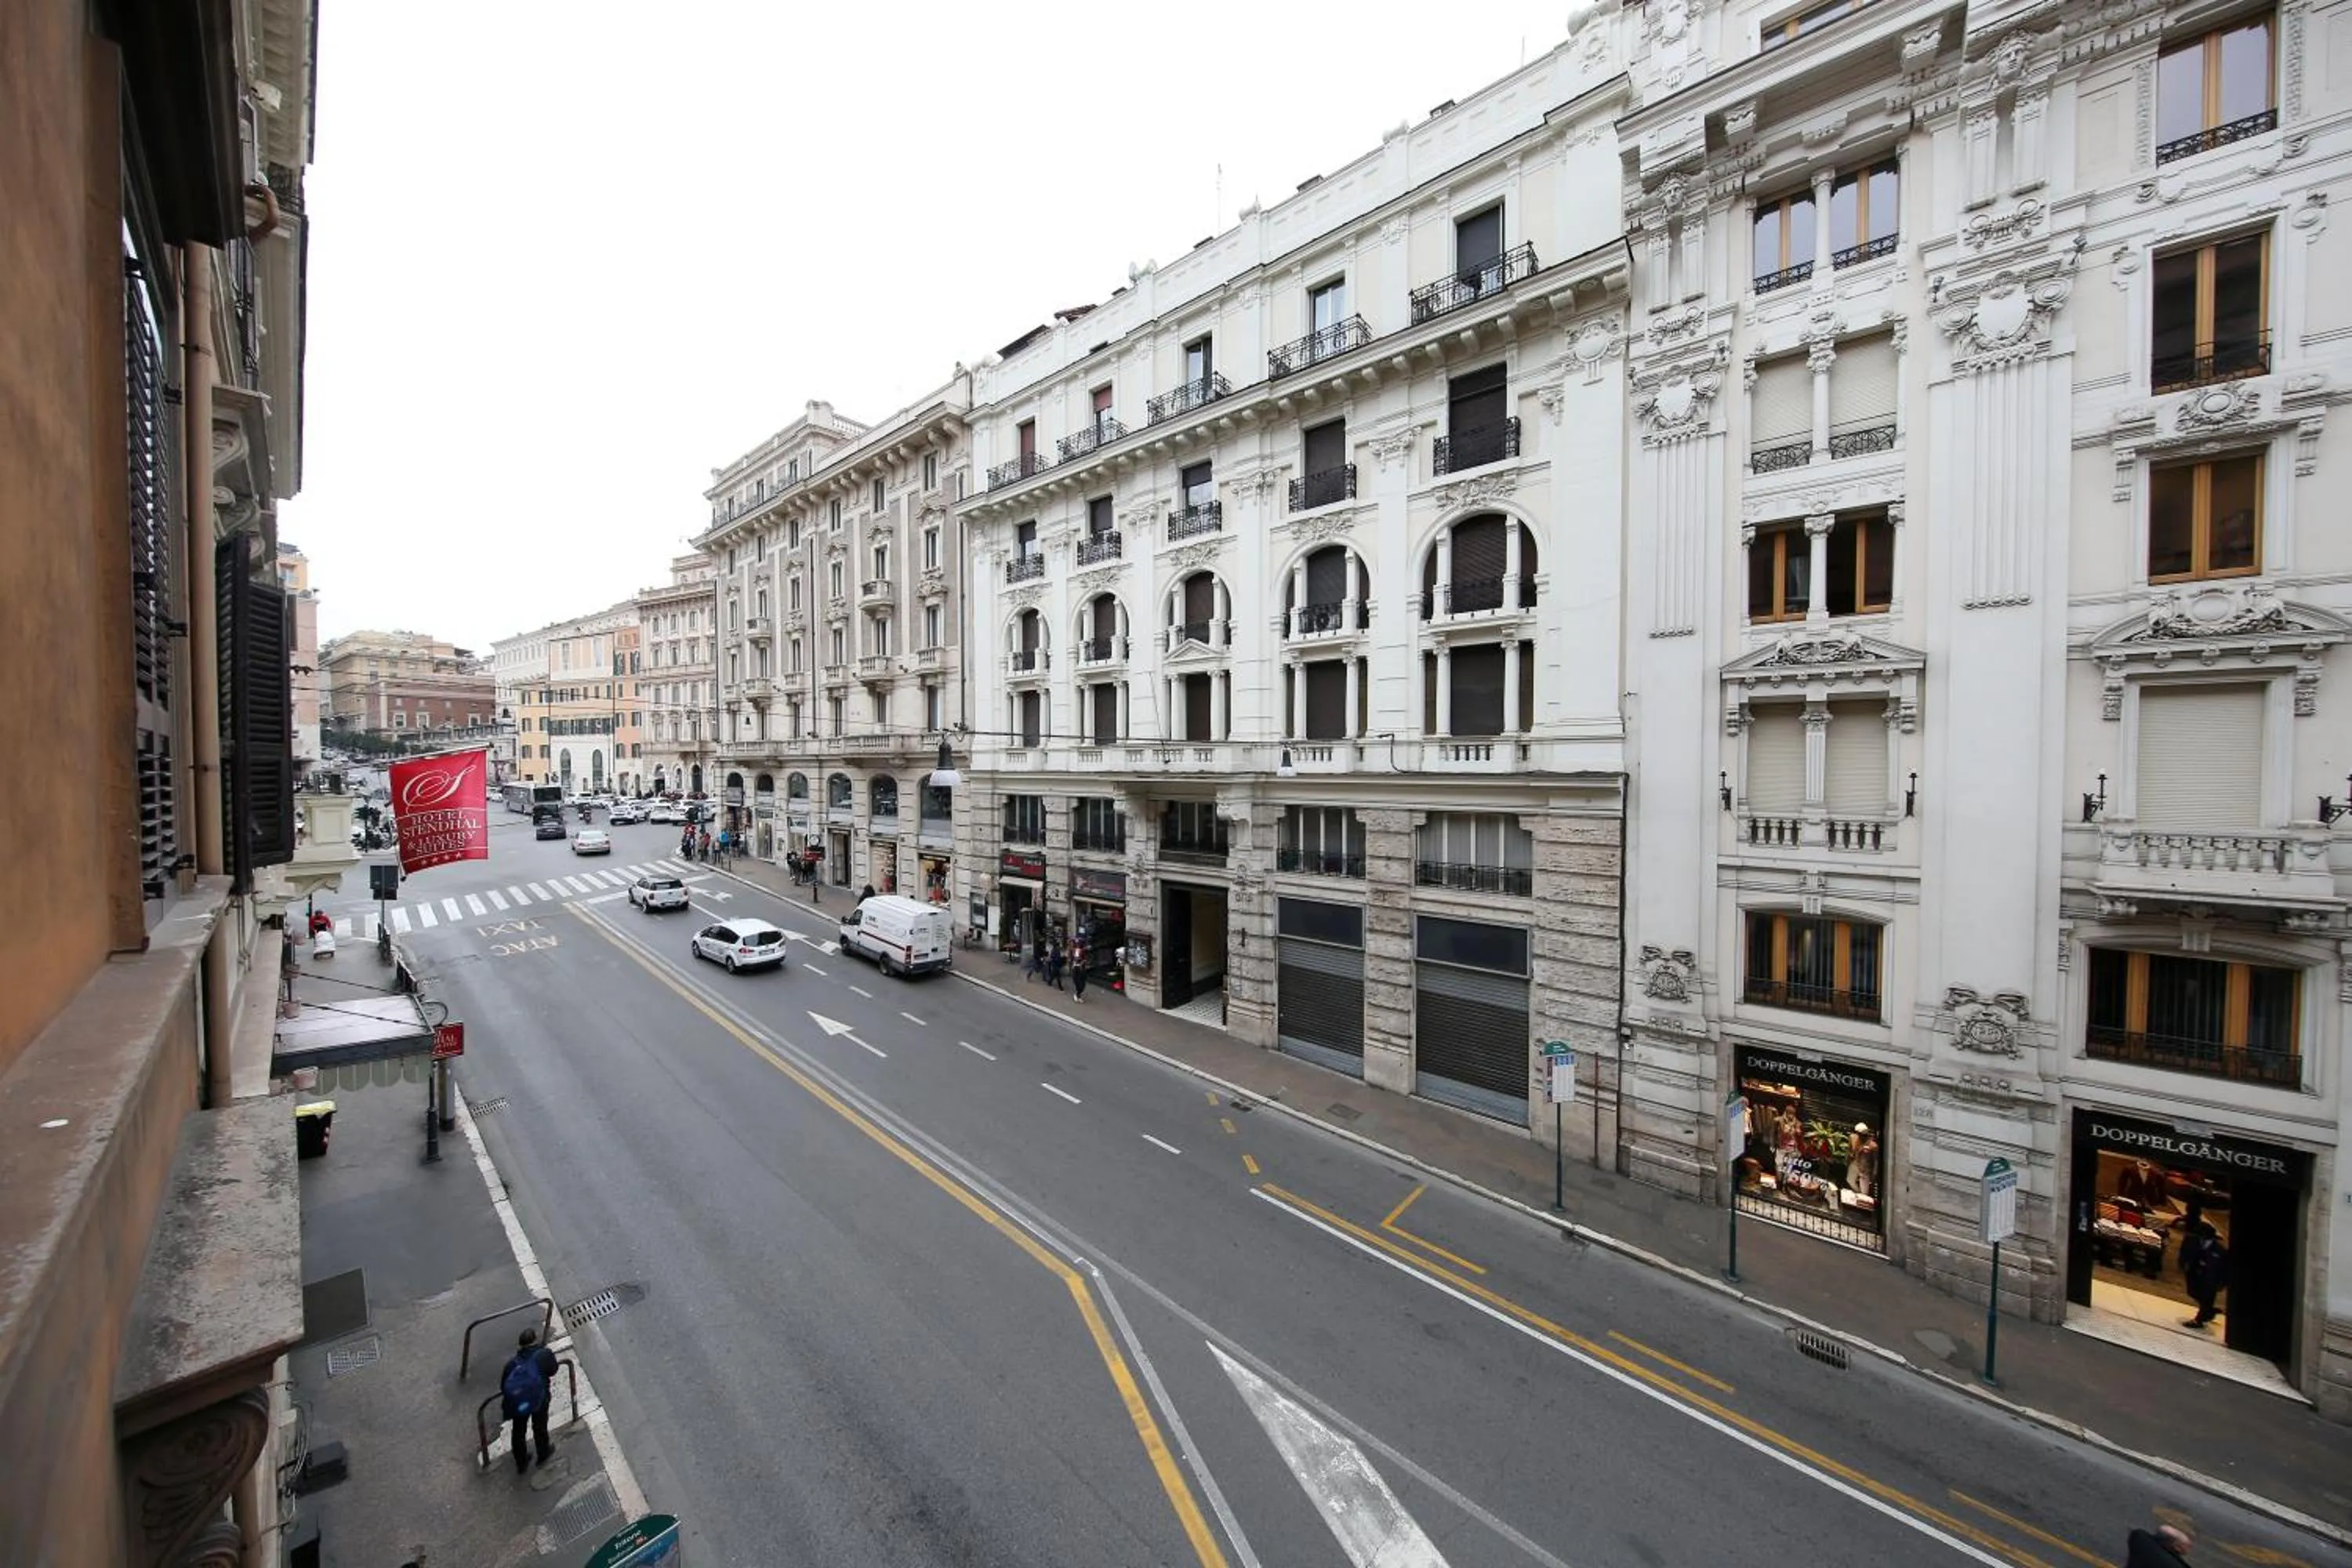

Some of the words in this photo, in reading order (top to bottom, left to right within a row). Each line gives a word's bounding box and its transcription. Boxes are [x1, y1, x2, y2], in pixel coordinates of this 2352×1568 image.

[412, 810, 466, 823] HOTEL
[402, 818, 482, 839] STENDHAL
[416, 839, 466, 856] SUITES
[418, 830, 477, 848] LUXURY
[1747, 1056, 1877, 1092] DOPPELGÄNGER
[2090, 1123, 2287, 1174] DOPPELGÄNGER
[614, 1530, 642, 1550] Tritone
